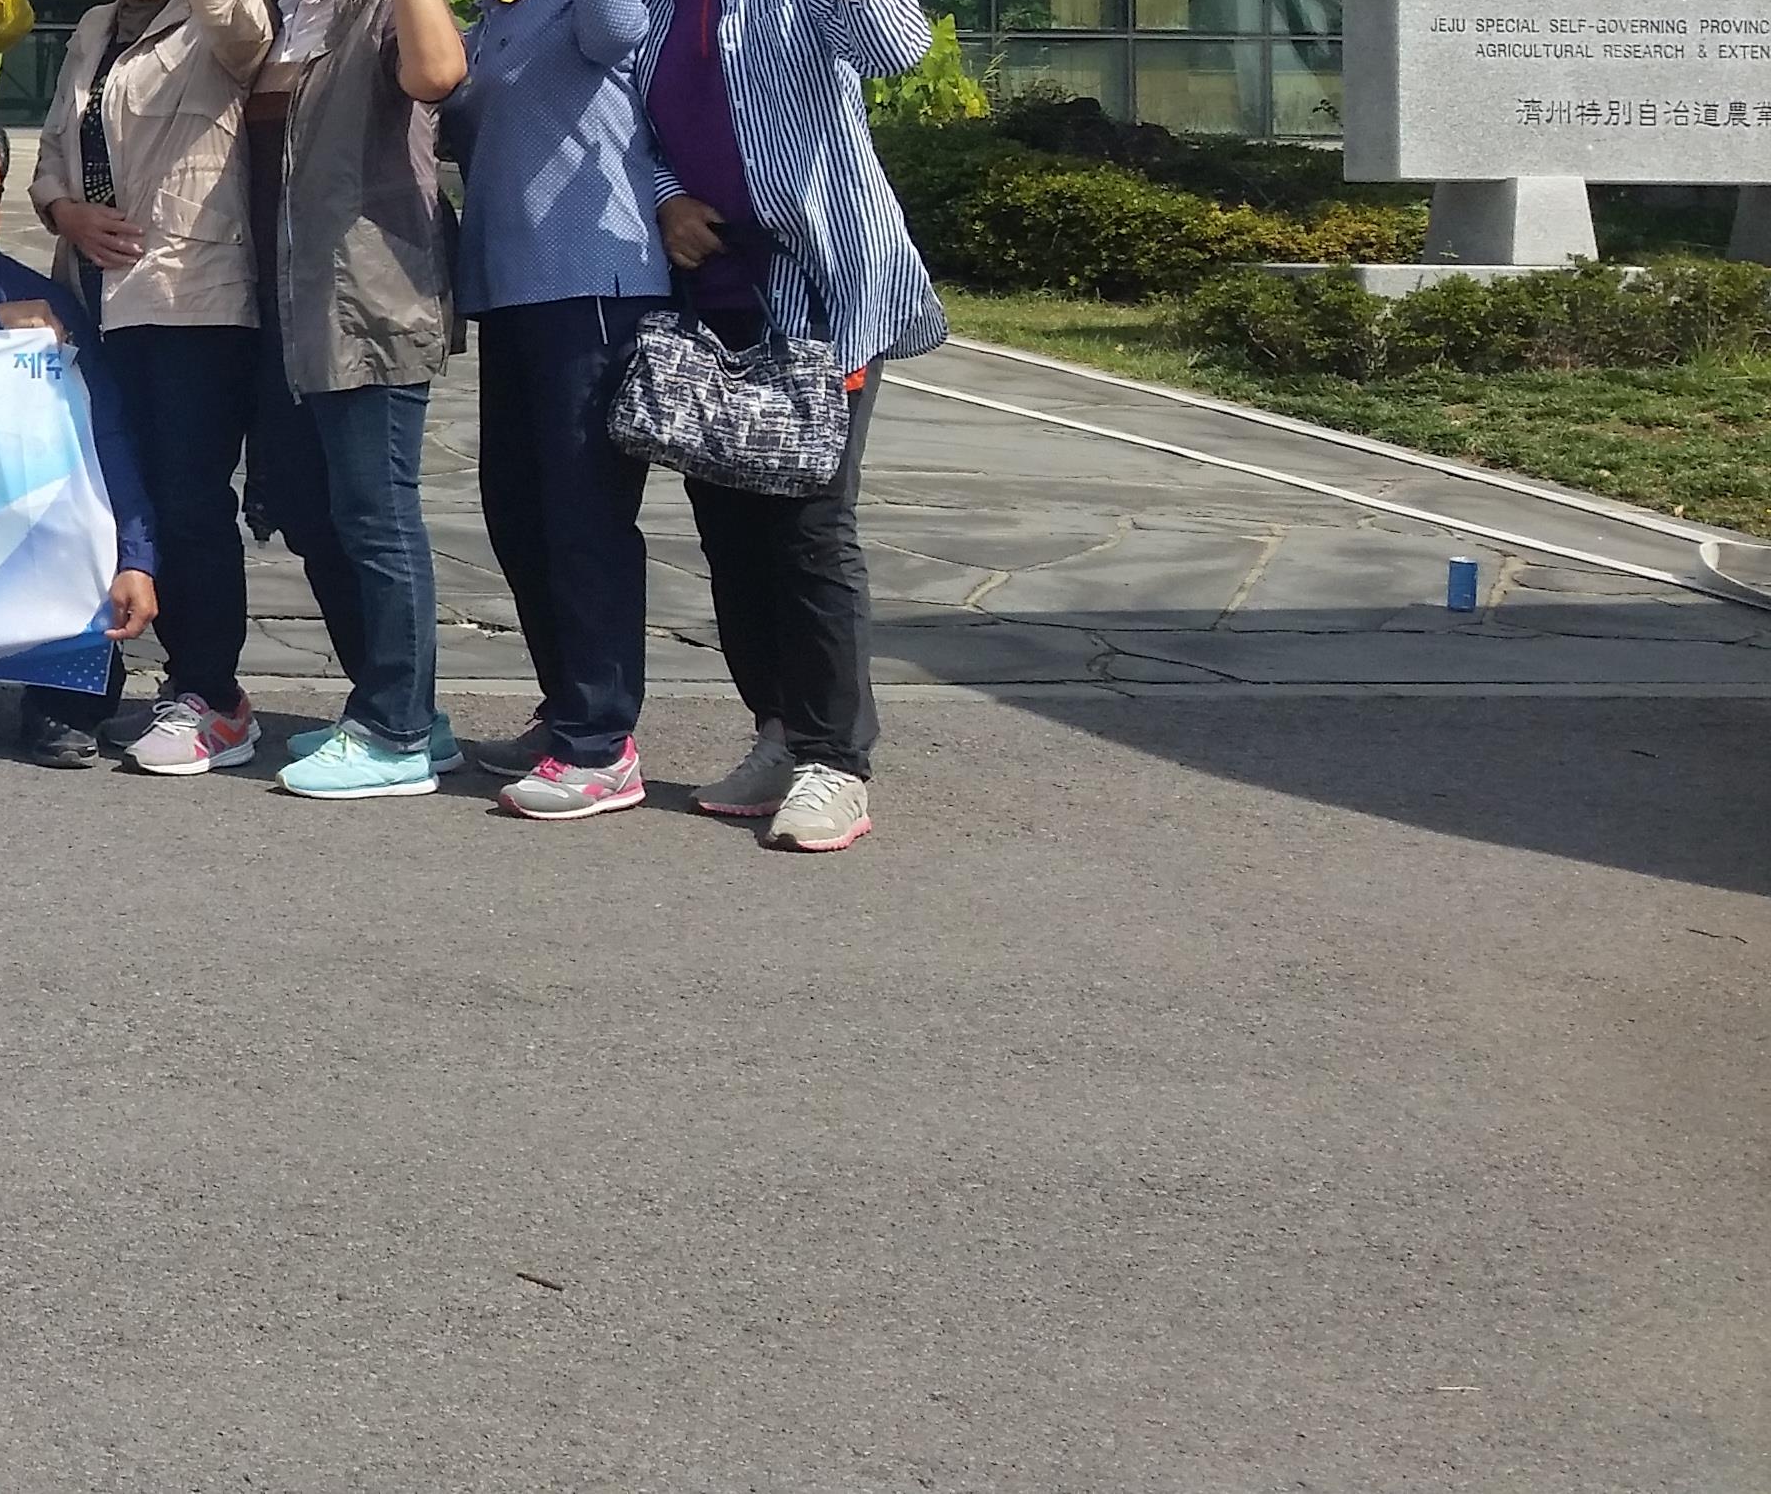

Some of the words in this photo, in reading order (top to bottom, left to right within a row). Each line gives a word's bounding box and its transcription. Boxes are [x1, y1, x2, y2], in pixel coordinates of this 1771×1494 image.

[1430, 17, 1466, 33] JEJU
[1475, 17, 1540, 34] SPECIAL
[1549, 17, 1688, 35] SELF-GOVERNING
[1699, 18, 1771, 35] PROVINC
[1475, 43, 1594, 59] AGRICULTURAL
[1603, 43, 1685, 59] RESEARCH
[1718, 44, 1771, 59] EXTEN
